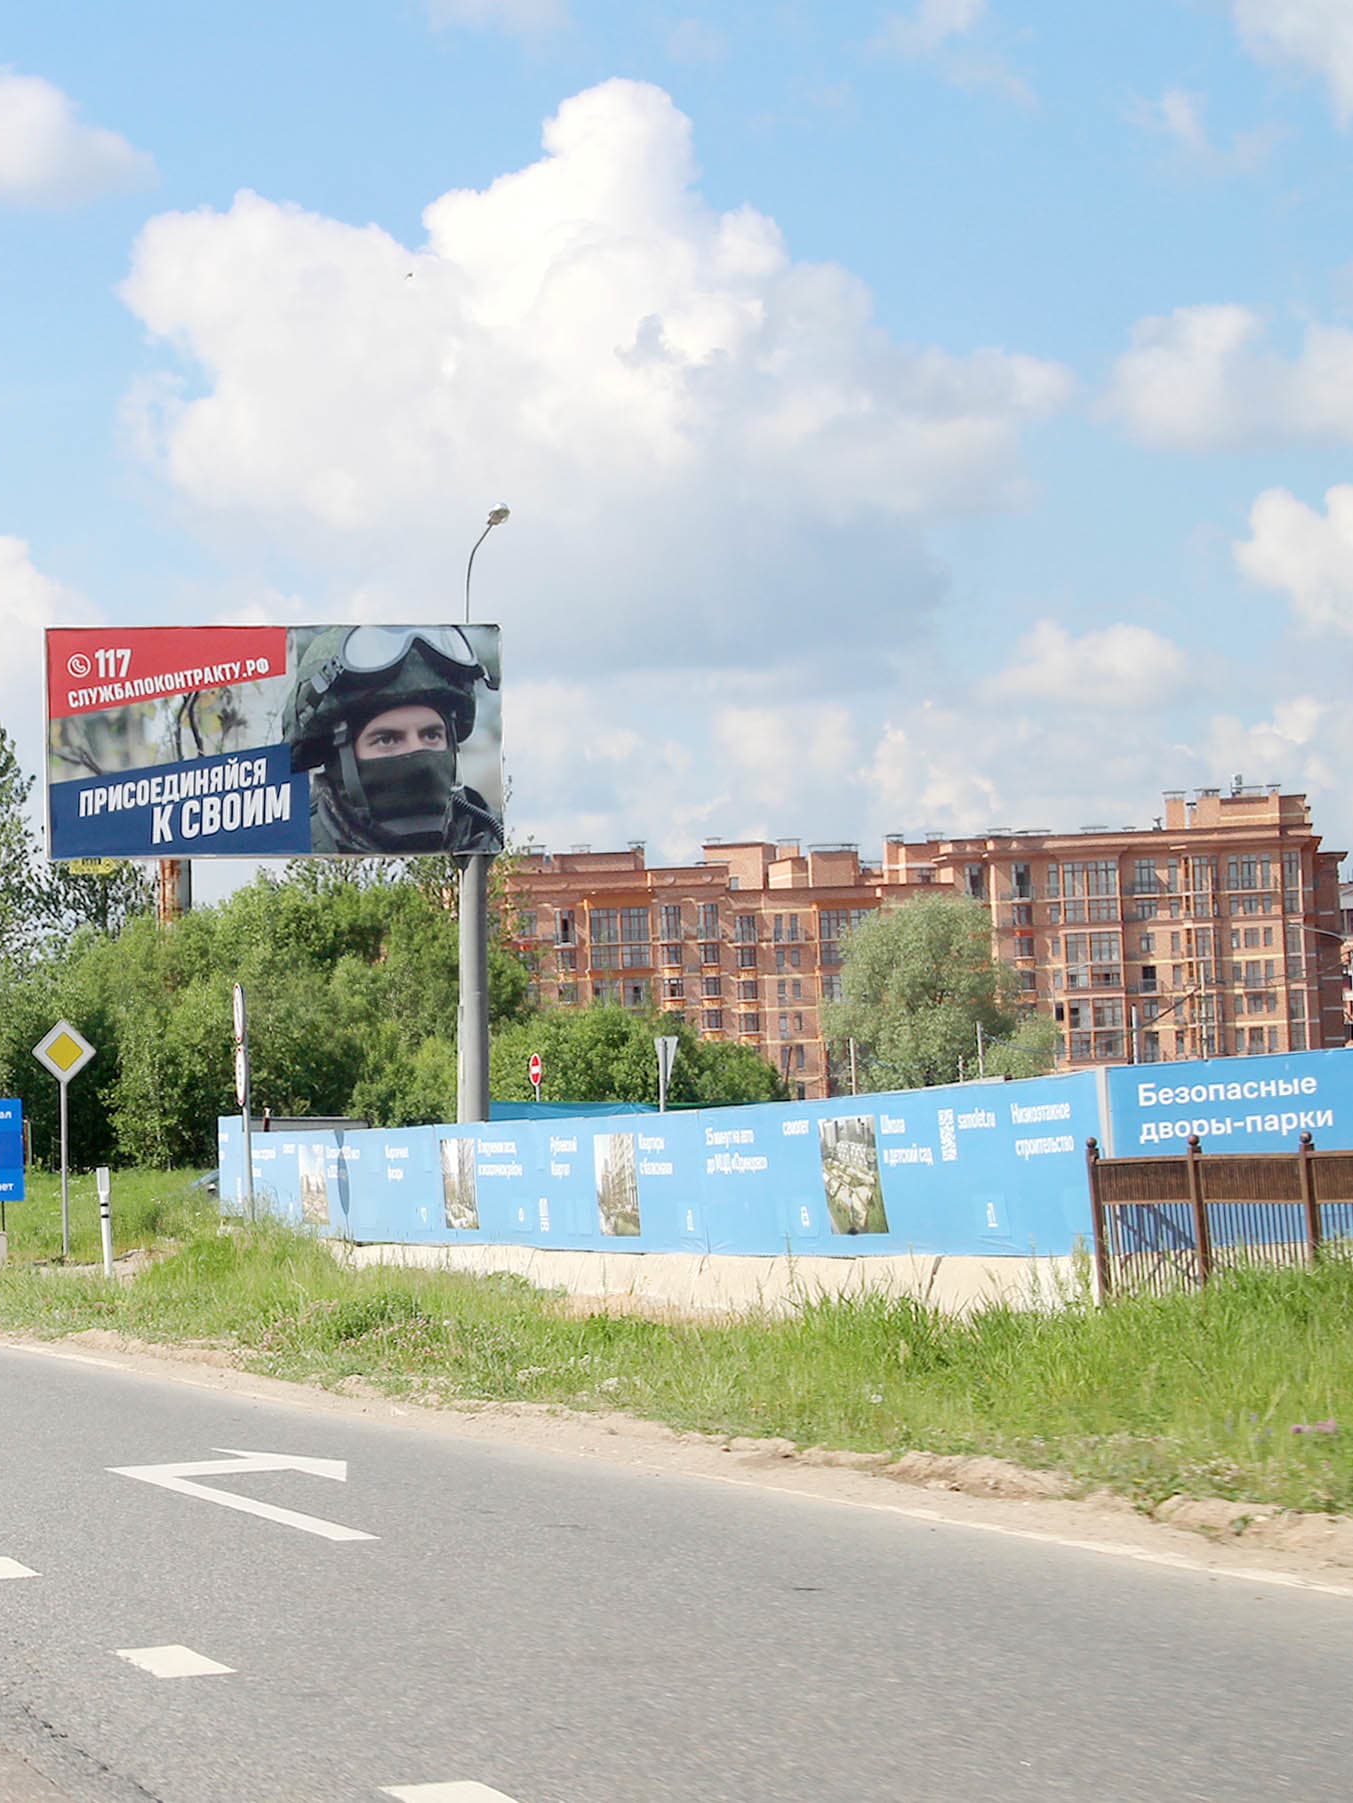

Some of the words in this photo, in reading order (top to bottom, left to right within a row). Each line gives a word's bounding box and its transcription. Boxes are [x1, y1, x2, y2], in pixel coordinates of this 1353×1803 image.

[67, 657, 271, 709] СЛУЖБАПОКОНТРАКТУ.РФ
[95, 648, 132, 678] 117
[79, 757, 268, 818] ПРИСОЕДИНЯЙСЯ
[152, 804, 174, 845] К
[180, 783, 292, 839] СВОИМ
[1138, 1076, 1318, 1107] Безопасные
[1139, 1109, 1333, 1143] дворы-парки
